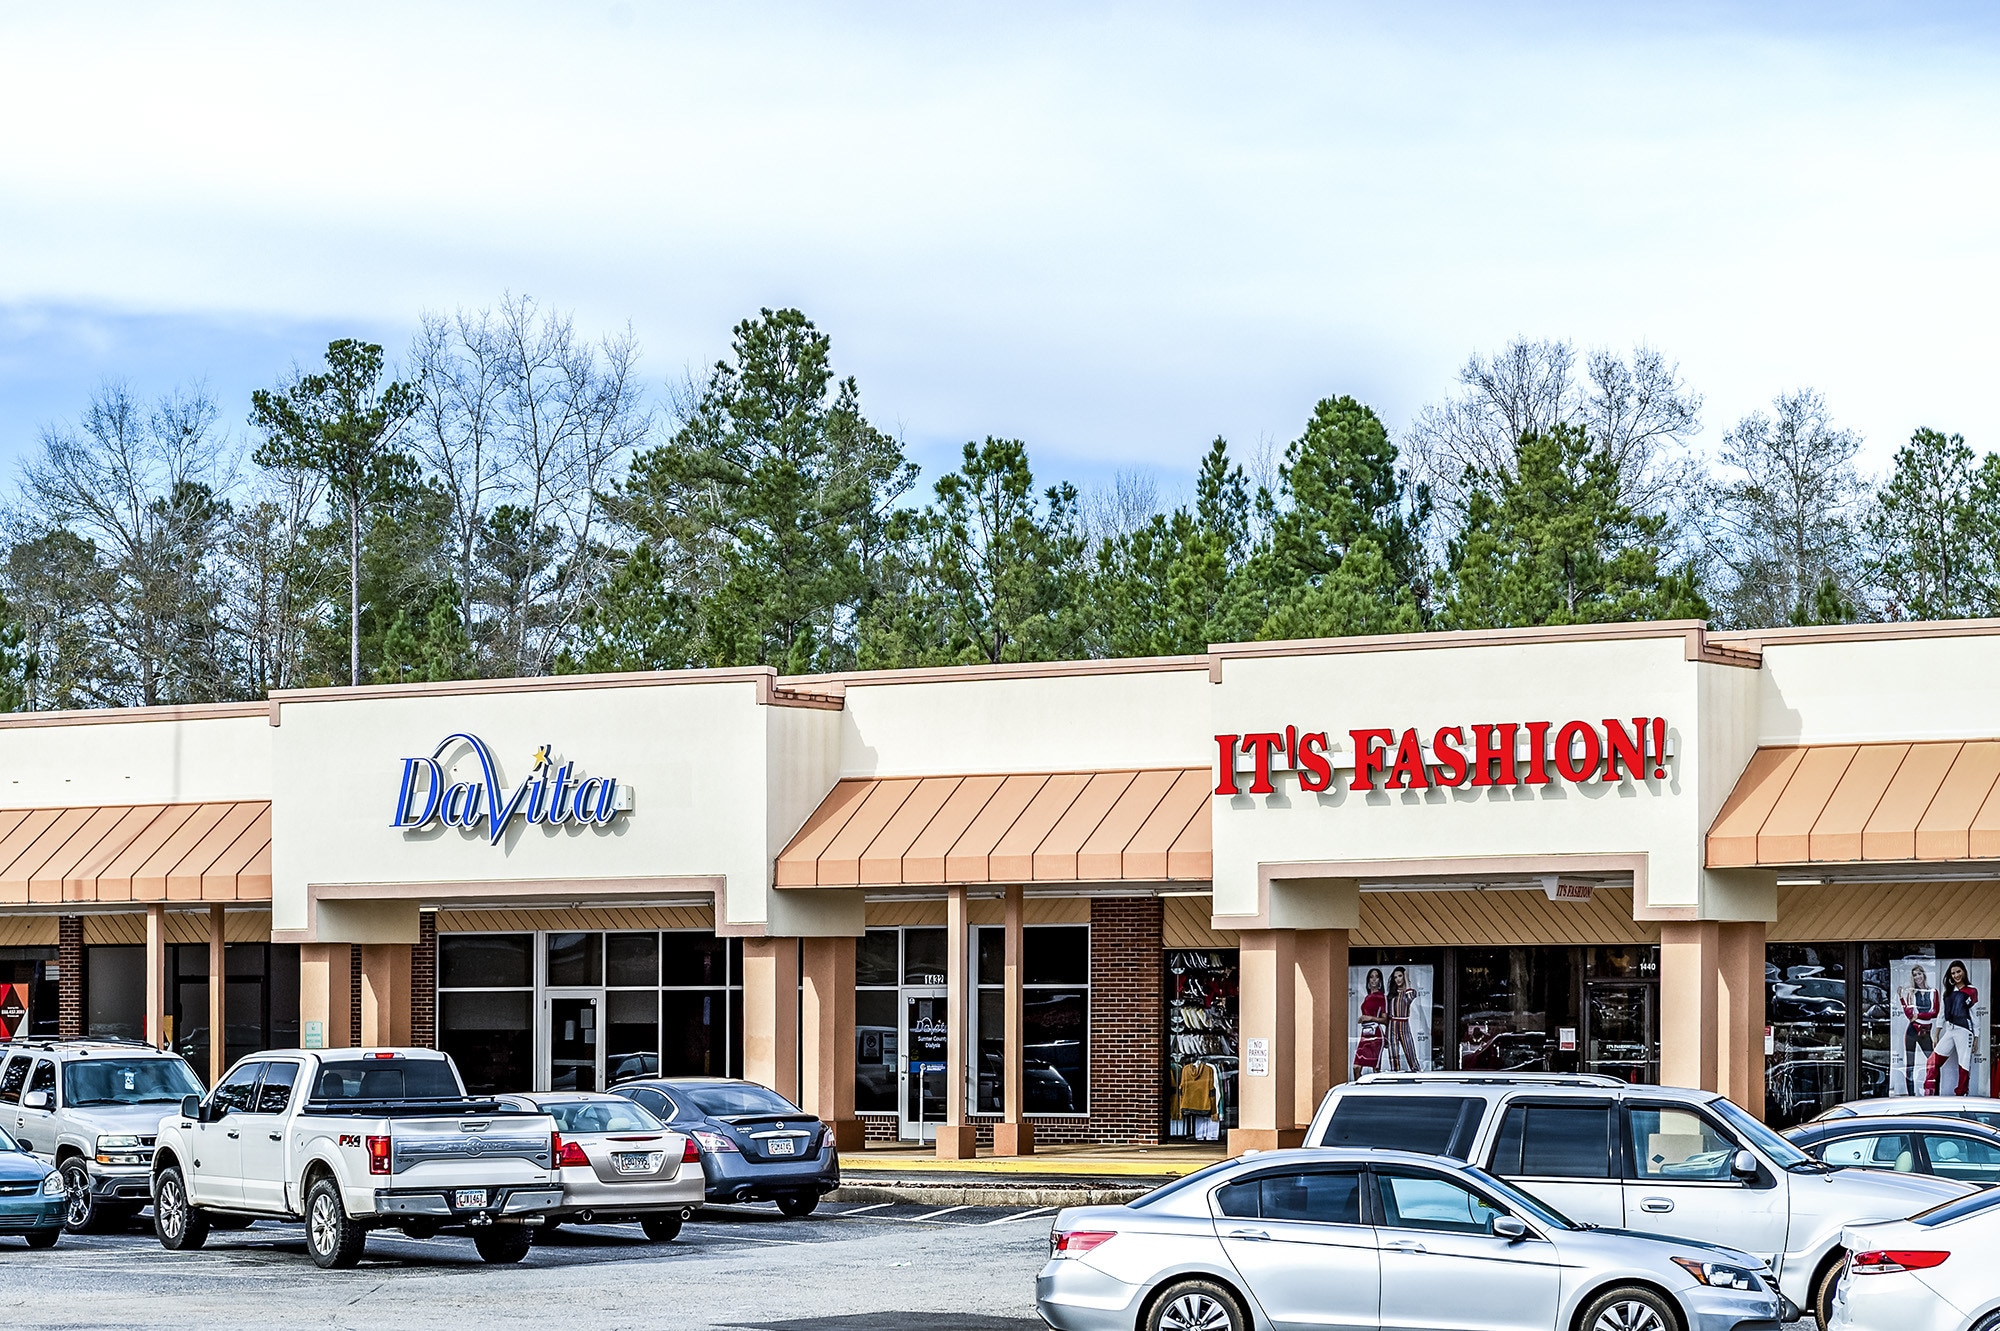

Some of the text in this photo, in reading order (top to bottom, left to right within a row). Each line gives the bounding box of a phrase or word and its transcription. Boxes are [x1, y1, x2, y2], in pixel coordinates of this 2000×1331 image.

[1214, 716, 1668, 795] IT'S FASHION!
[388, 732, 618, 847] DaVita
[1640, 963, 1656, 971] 1440
[925, 974, 944, 984] 1432
[339, 1135, 361, 1146] FX4
